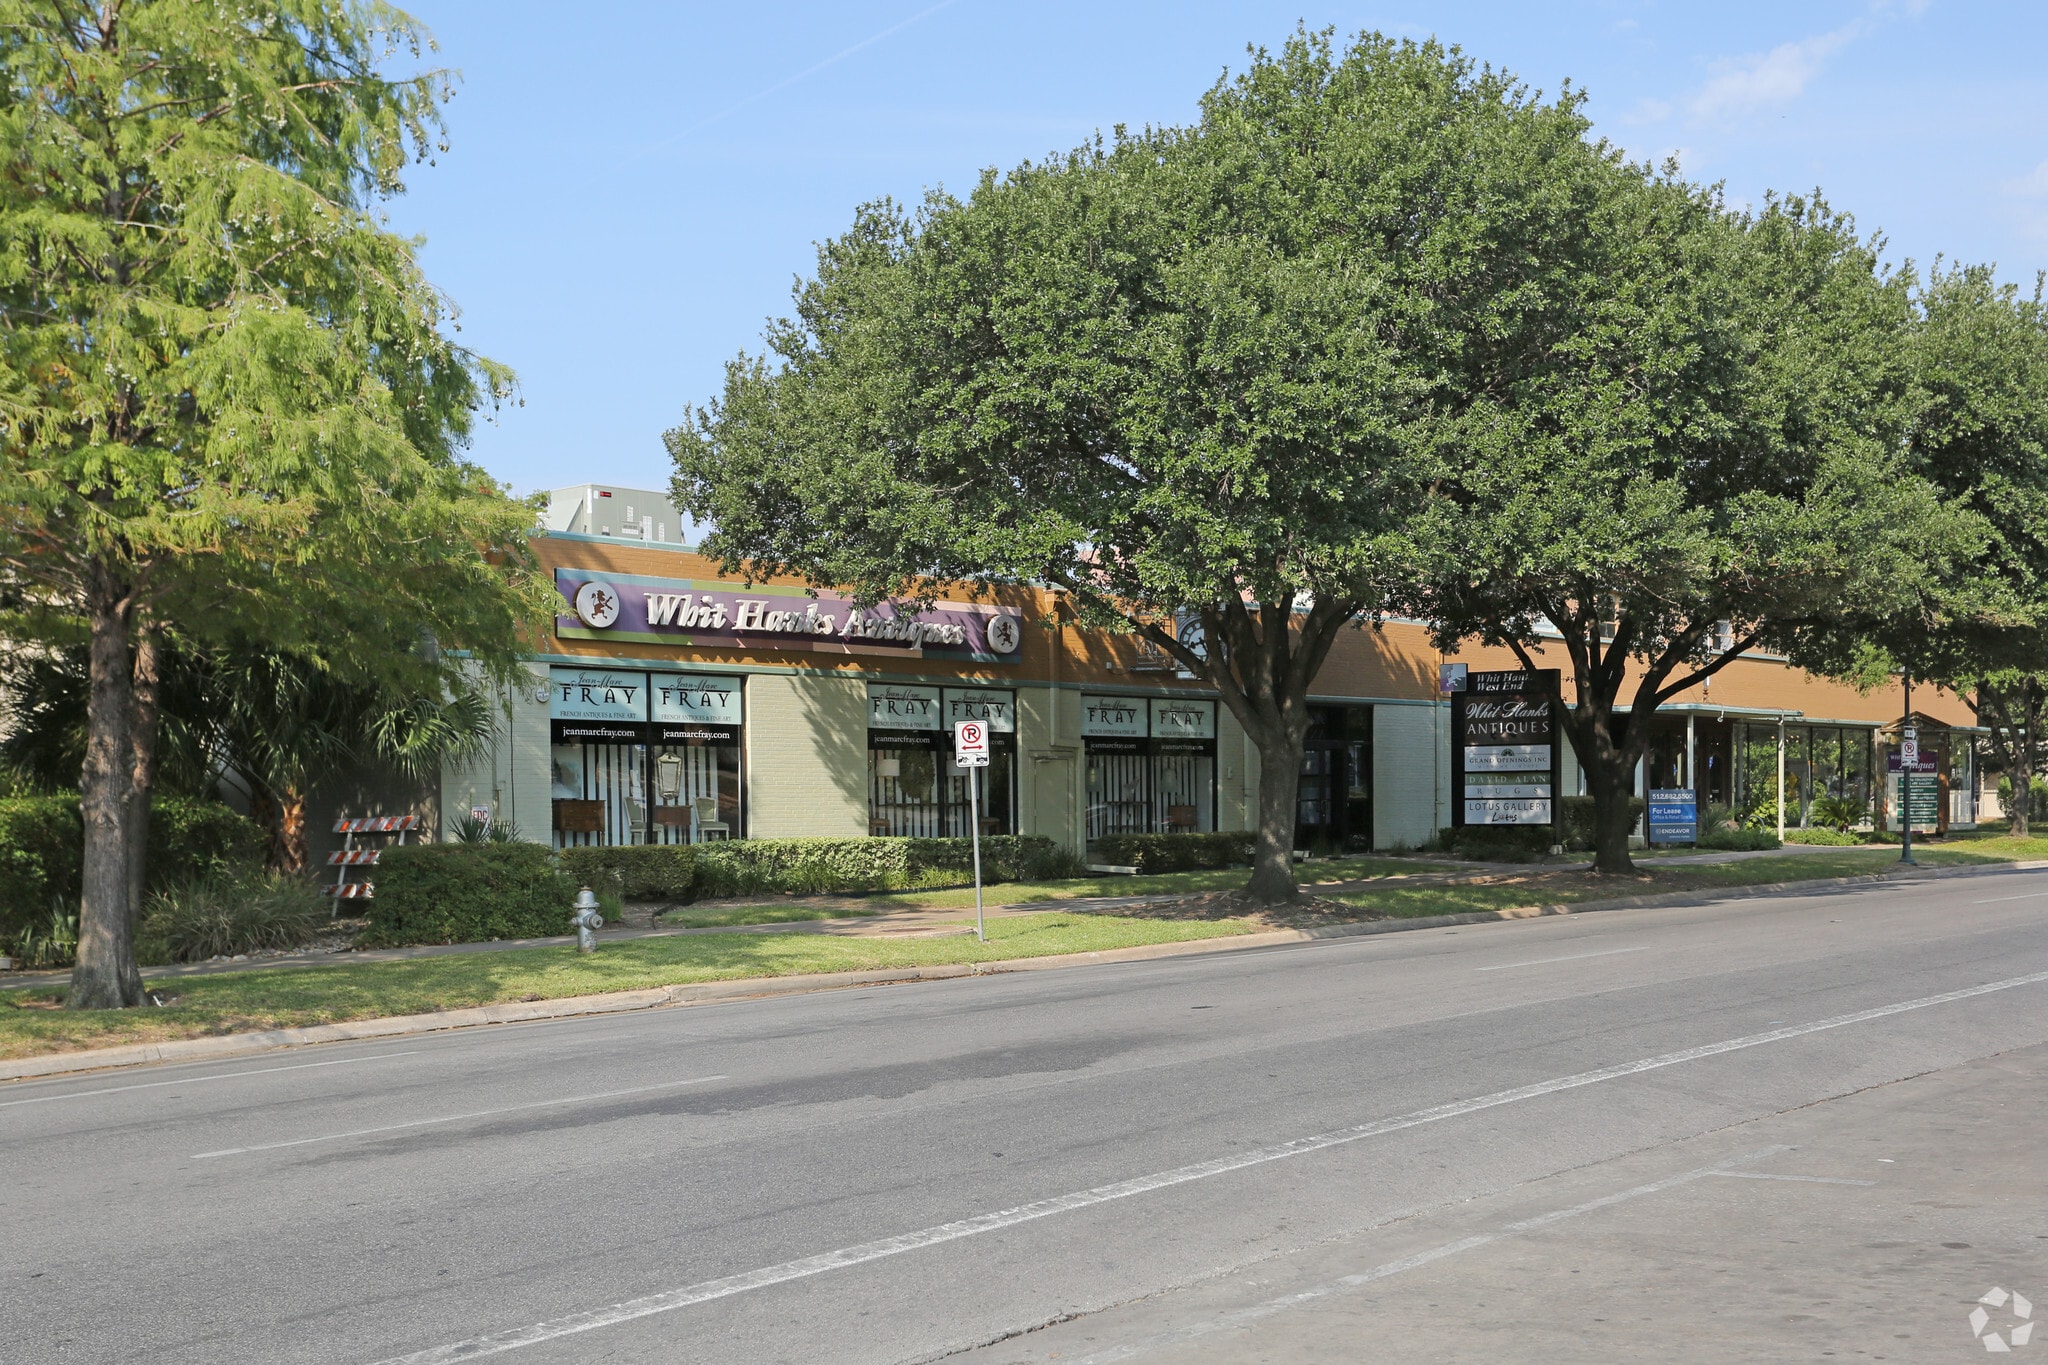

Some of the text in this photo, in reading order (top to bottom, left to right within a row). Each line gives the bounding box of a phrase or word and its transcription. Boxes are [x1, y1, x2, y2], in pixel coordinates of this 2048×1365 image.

[643, 592, 728, 629] Whit
[731, 599, 836, 636] Hanks
[571, 672, 623, 689] Jean-Marc
[669, 677, 718, 692] Jean-Marc
[1477, 673, 1500, 682] Whit
[1477, 681, 1524, 691] West End
[562, 687, 635, 707] FRAY
[662, 691, 729, 709] FRAY
[582, 711, 609, 719] ANTIQUES
[873, 700, 929, 716] FRAY
[952, 703, 1004, 720] FRAY
[1465, 701, 1549, 719] Whit Hanks
[1089, 710, 1136, 725] FRAY
[1160, 713, 1203, 727] FRAY
[563, 727, 635, 739] jeanmarcfray.com
[663, 729, 730, 740] jeanmarcfray.com
[1467, 721, 1549, 735] ANTIQUES
[874, 735, 930, 745] jeanmarcfray.com
[1469, 775, 1546, 784] DAVID ALAN
[1477, 787, 1538, 795] RUGS
[1469, 802, 1547, 811] LOTUS GALLERY
